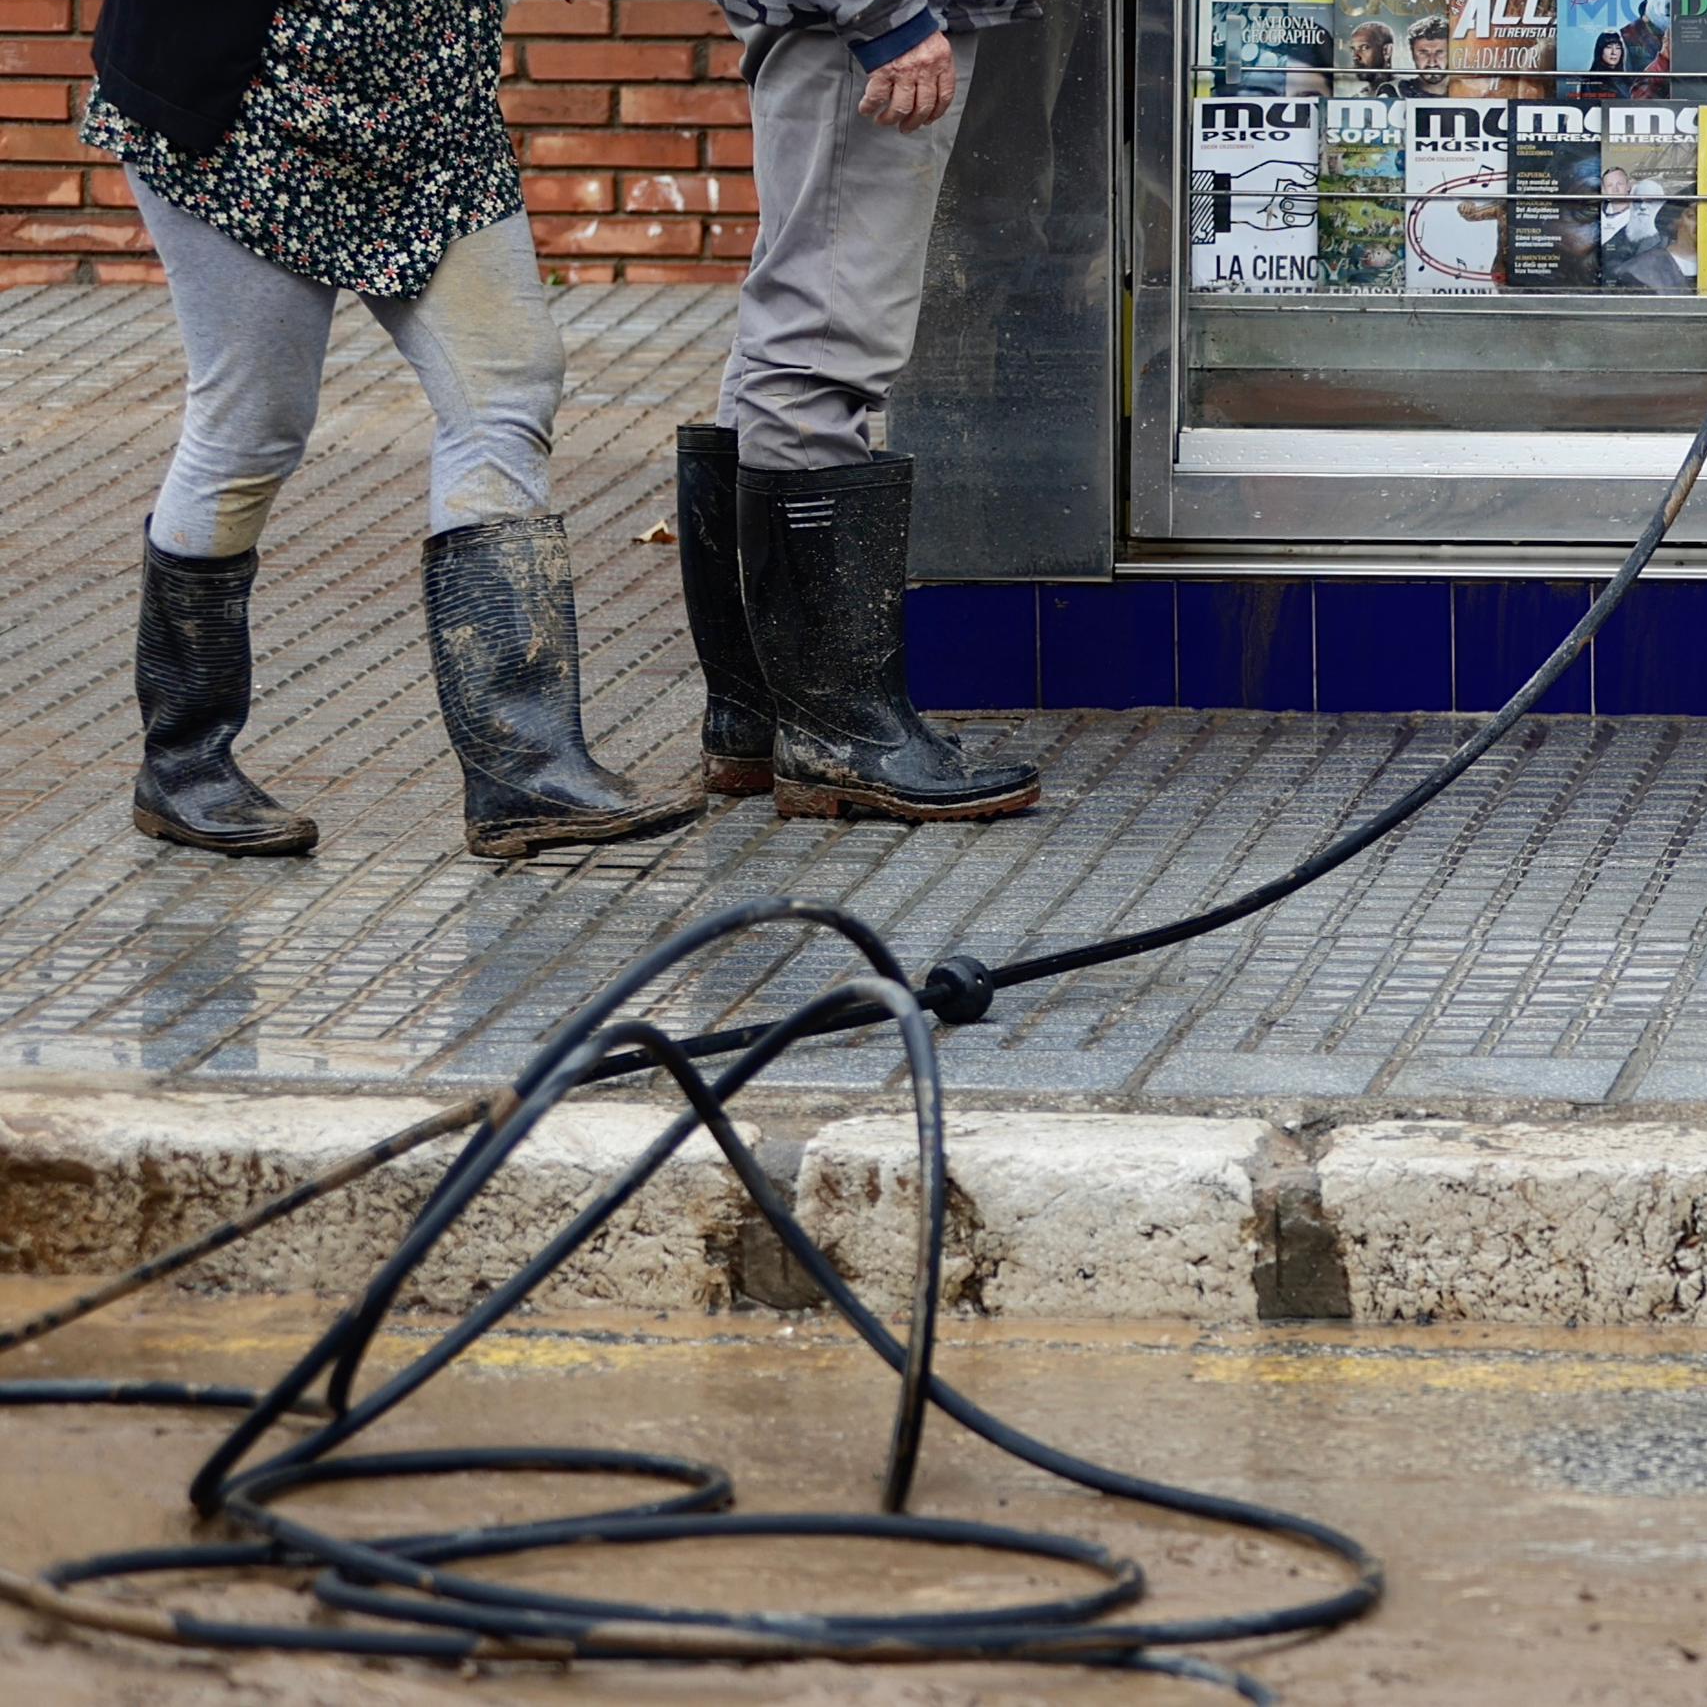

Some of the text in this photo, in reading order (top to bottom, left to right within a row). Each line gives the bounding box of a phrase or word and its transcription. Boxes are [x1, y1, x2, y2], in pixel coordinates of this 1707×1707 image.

[1252, 16, 1318, 30] NATIONAL
[1242, 30, 1325, 45] GEOGRAPHIC
[1507, 28, 1546, 37] REVISTA
[1452, 46, 1540, 69] GLADIATOR
[1202, 130, 1290, 142] PSICO
[1216, 255, 1241, 281] LA
